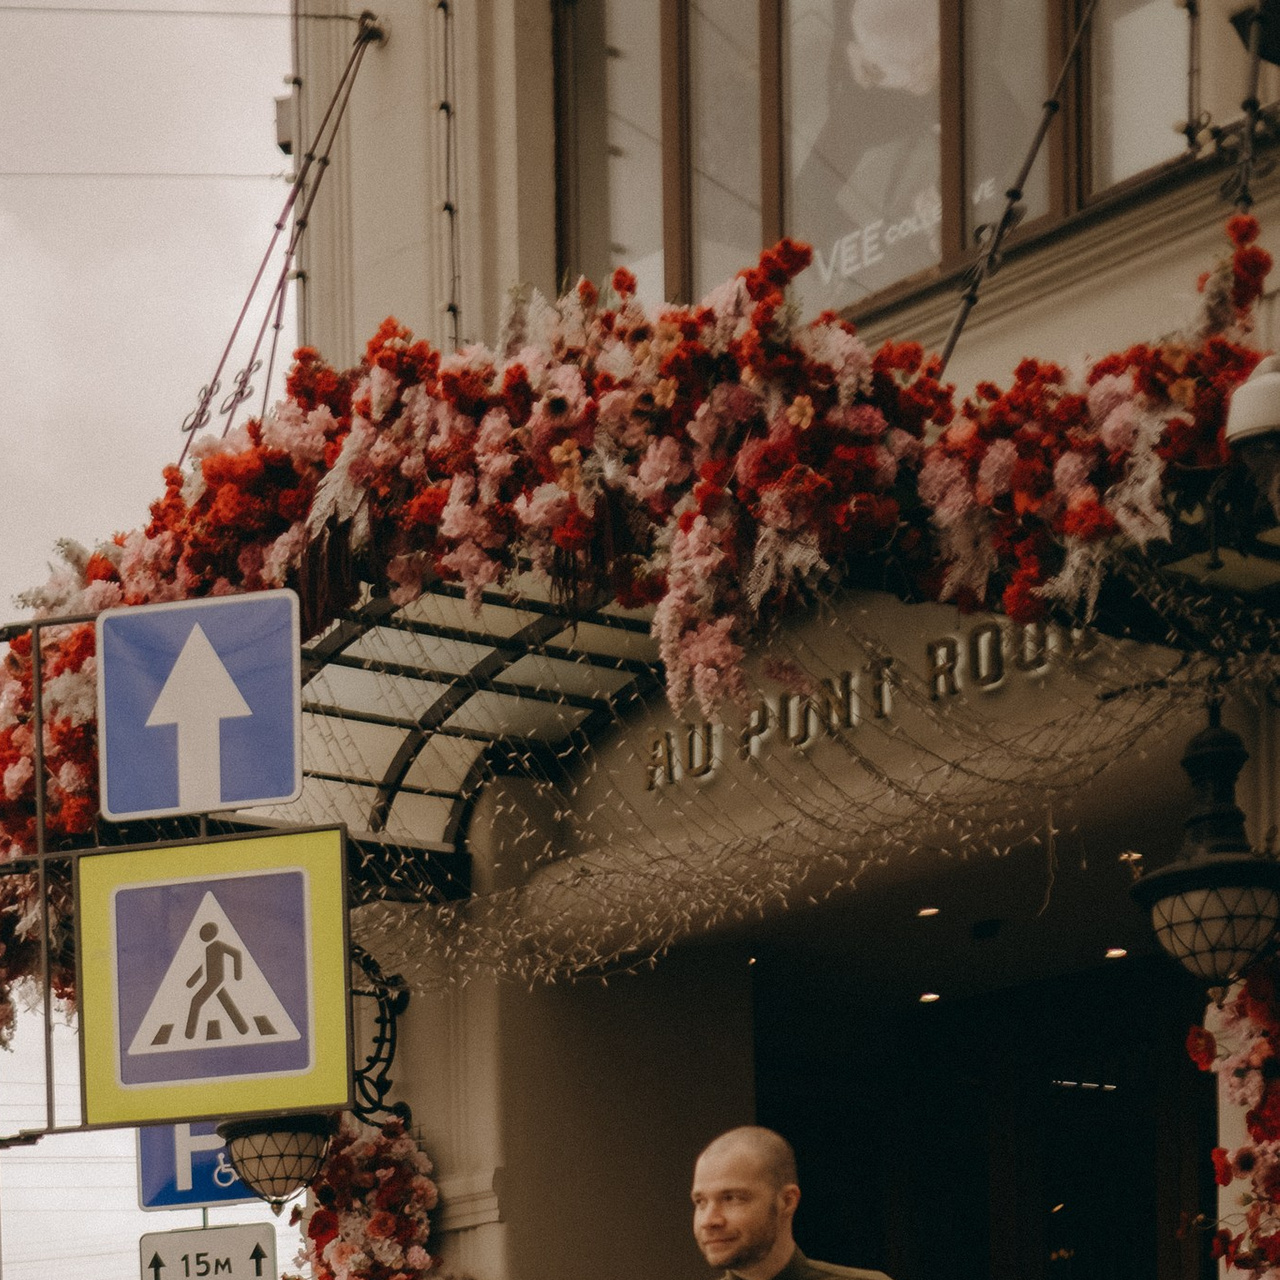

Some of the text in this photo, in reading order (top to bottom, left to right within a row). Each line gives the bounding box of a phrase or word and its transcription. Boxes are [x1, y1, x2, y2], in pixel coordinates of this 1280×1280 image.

[815, 219, 885, 285] VEE
[646, 723, 714, 791] AU
[737, 656, 894, 761] PONT
